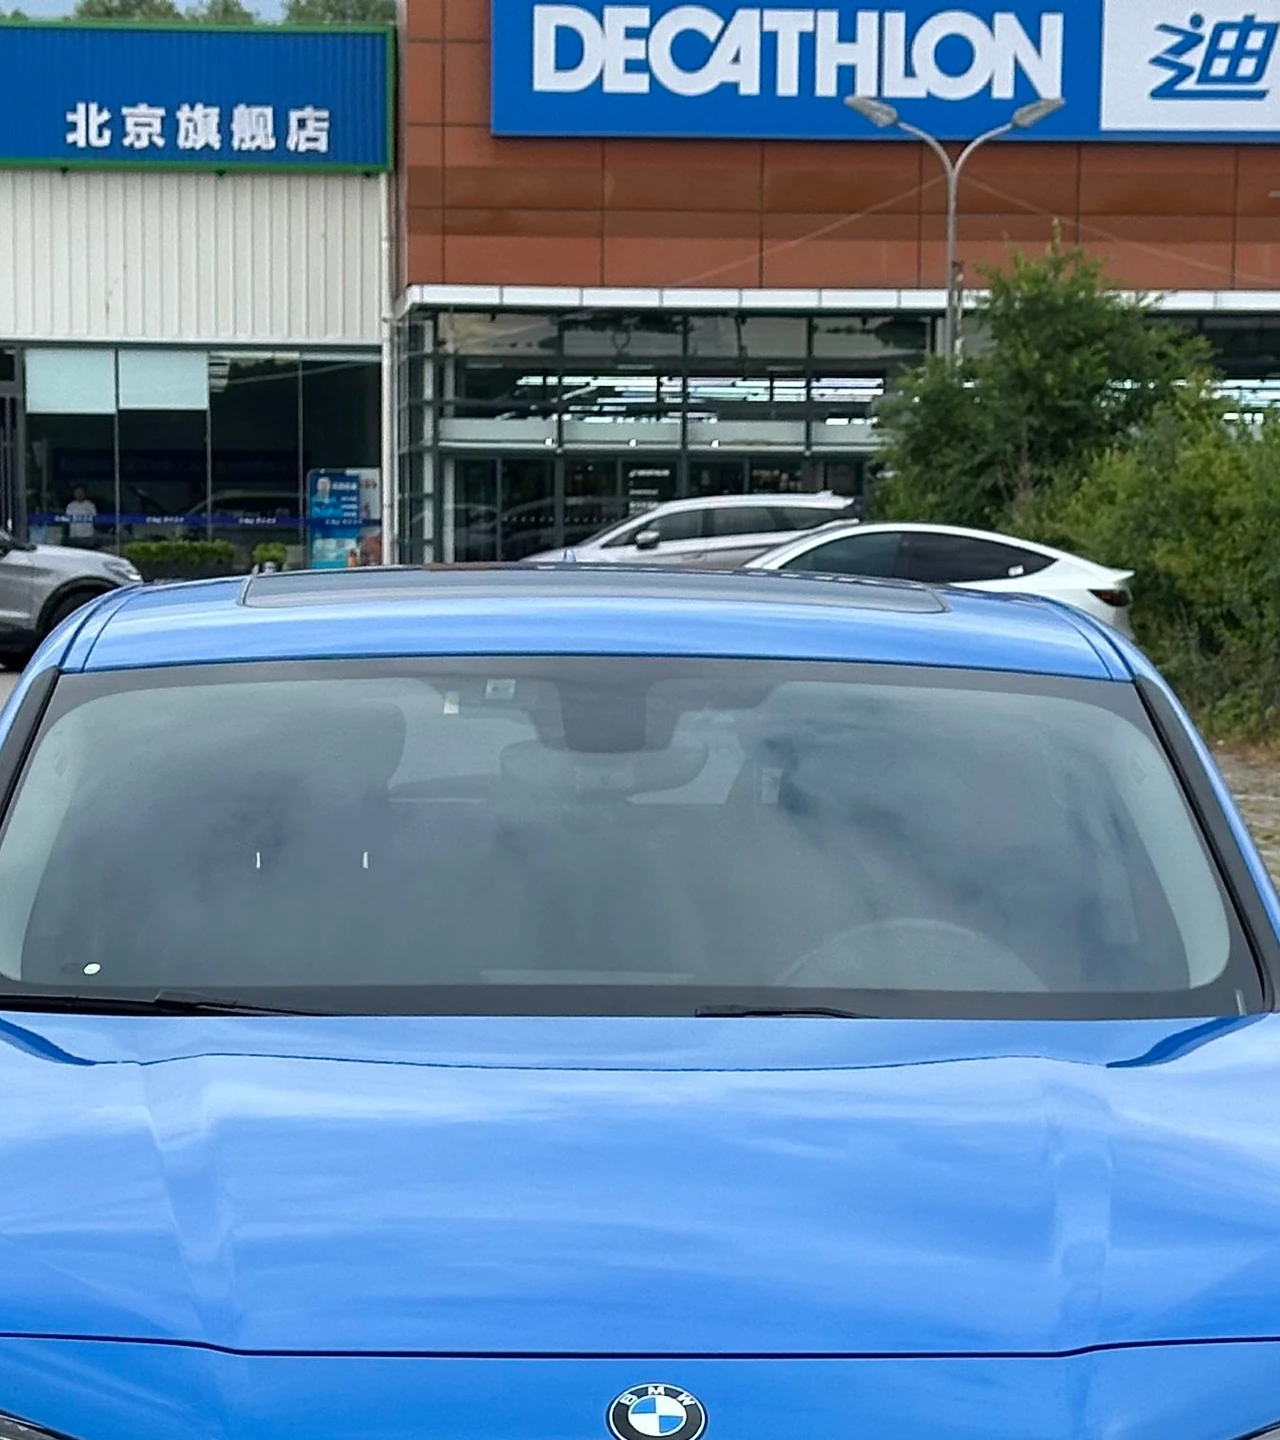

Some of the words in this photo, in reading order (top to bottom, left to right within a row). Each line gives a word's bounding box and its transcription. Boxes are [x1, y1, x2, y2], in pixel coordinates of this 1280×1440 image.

[532, 4, 1065, 101] DECATHLON
[65, 102, 331, 153] 北京旗舰店
[619, 1386, 696, 1406] BMW
